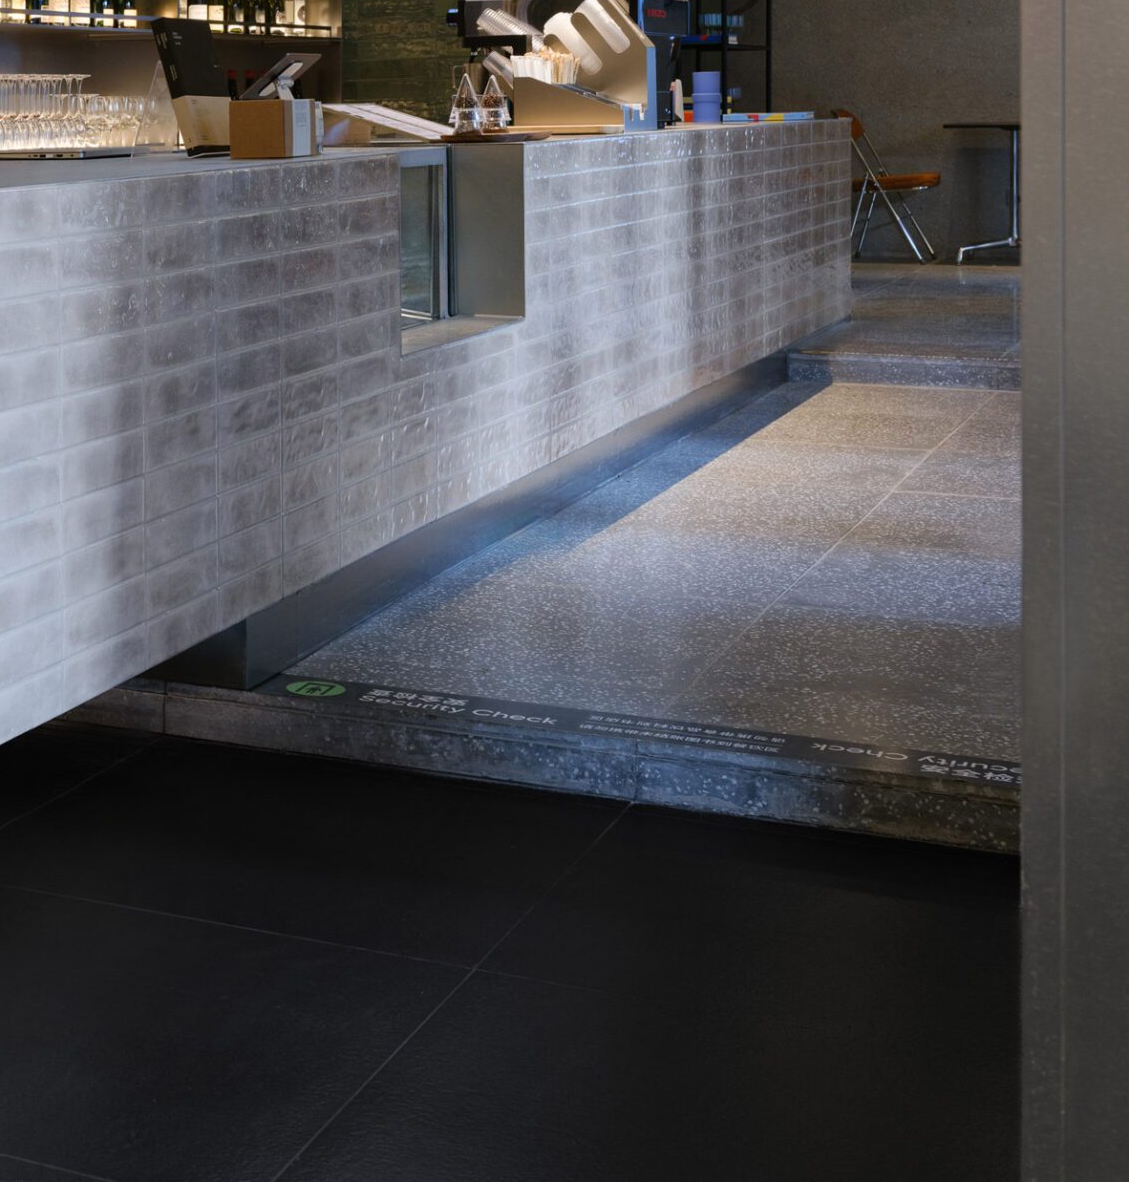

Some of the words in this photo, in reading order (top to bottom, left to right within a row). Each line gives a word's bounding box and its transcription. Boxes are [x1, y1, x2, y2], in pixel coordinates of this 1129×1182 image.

[358, 695, 466, 714] Security
[471, 708, 559, 725] Check
[811, 742, 909, 761] Check
[920, 763, 1023, 785] 安全检
